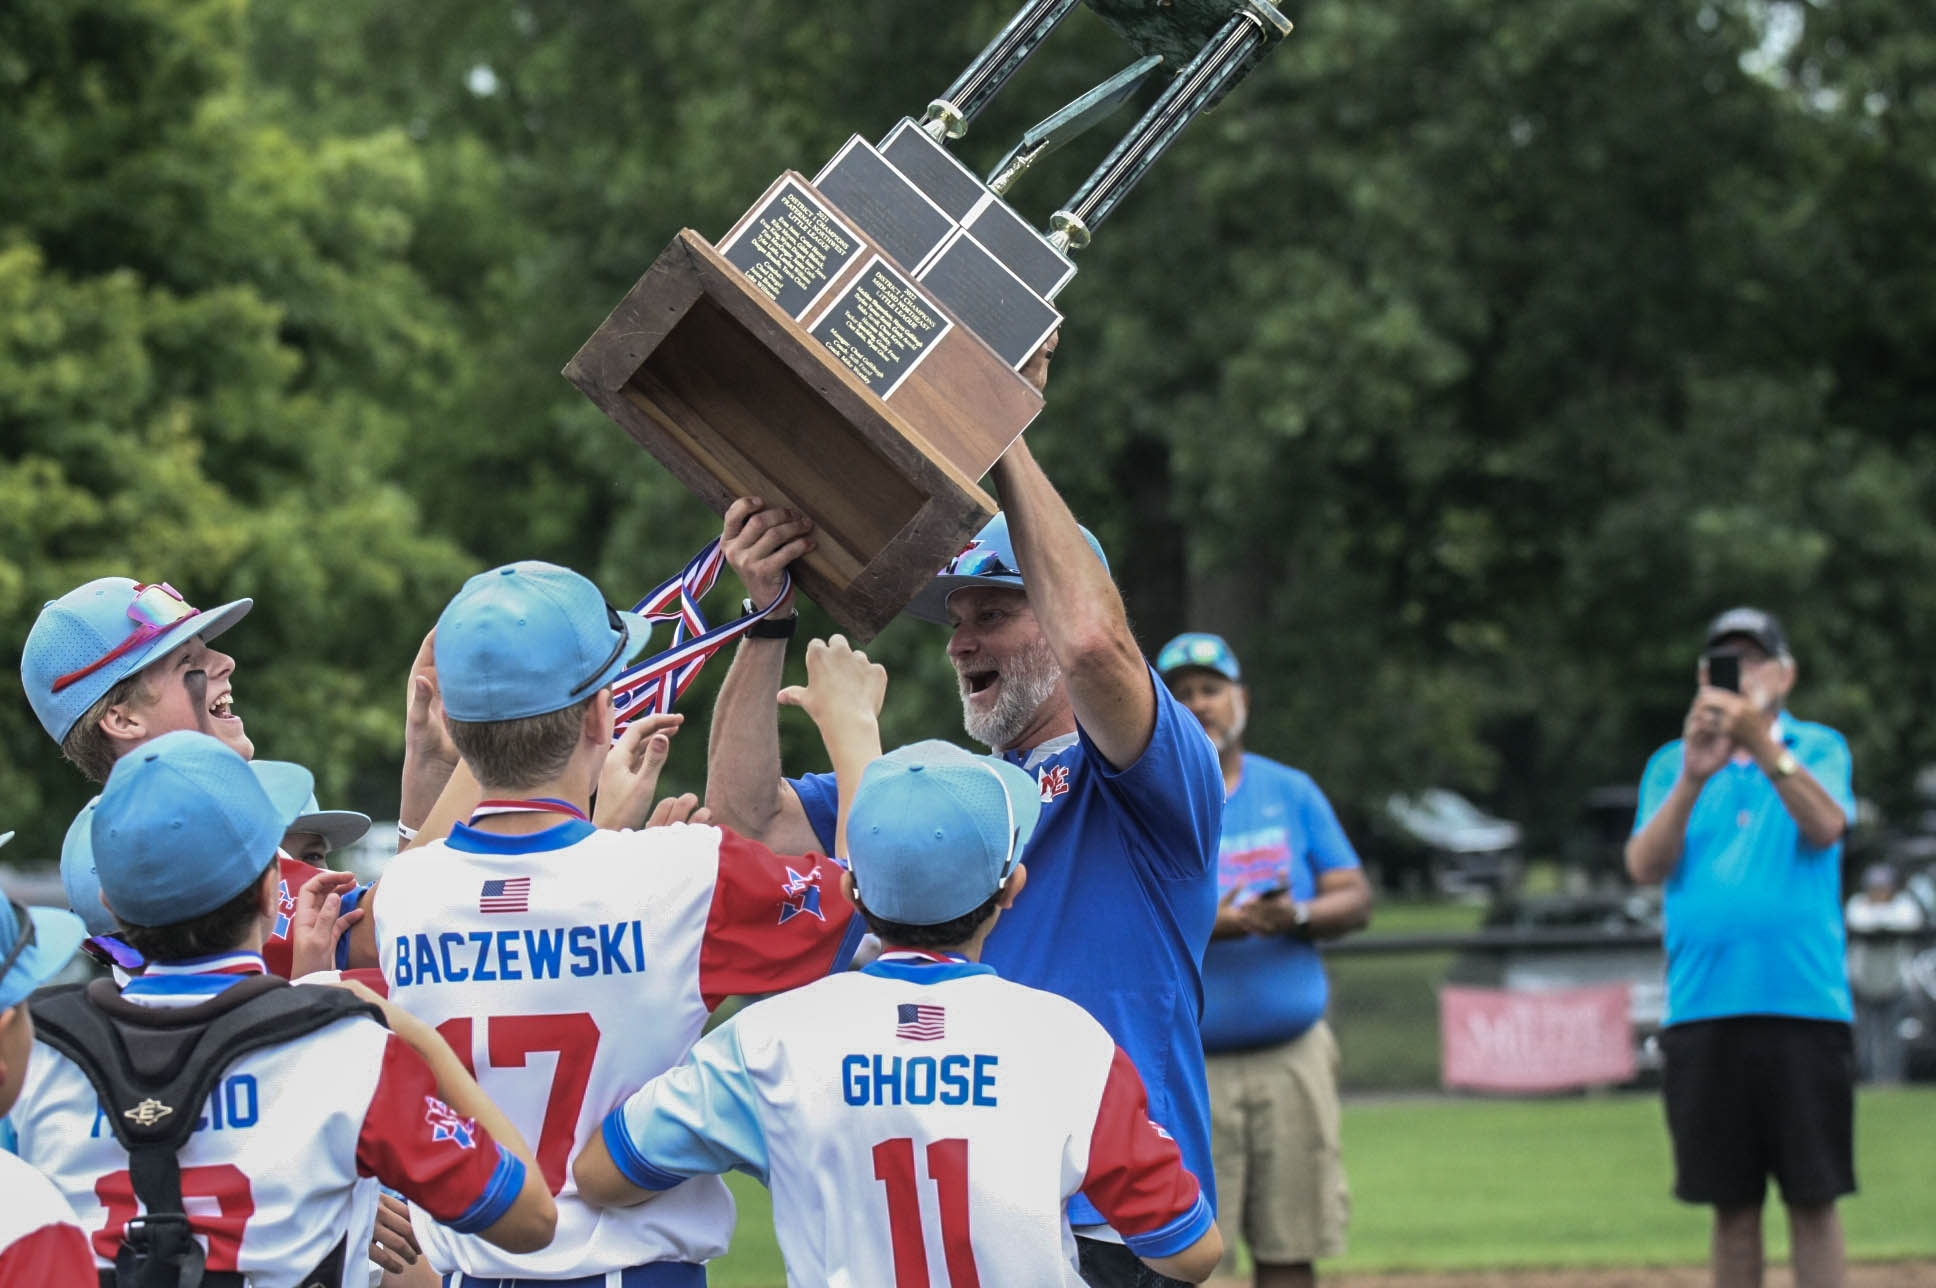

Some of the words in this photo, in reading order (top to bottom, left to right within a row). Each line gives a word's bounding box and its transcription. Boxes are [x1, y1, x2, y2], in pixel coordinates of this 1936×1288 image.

[780, 196, 813, 227] FRATERNAL
[811, 224, 846, 256] NORTHWEST
[787, 193, 813, 218] DISTRICT
[815, 218, 848, 250] CHAMPIONS
[787, 211, 808, 231] LITTLE
[806, 229, 830, 251] LEAGUE
[871, 277, 899, 303] MIDLAND
[896, 300, 930, 331] NORTHEAST
[874, 271, 901, 295] DISTRICT
[902, 296, 936, 327] CHAMPIONS
[875, 289, 895, 309] LITTLE
[893, 306, 918, 329] LEAGUE
[395, 920, 647, 987] BACZEWSKI
[841, 1054, 998, 1107] GHOSE
[872, 1137, 981, 1288] 11
